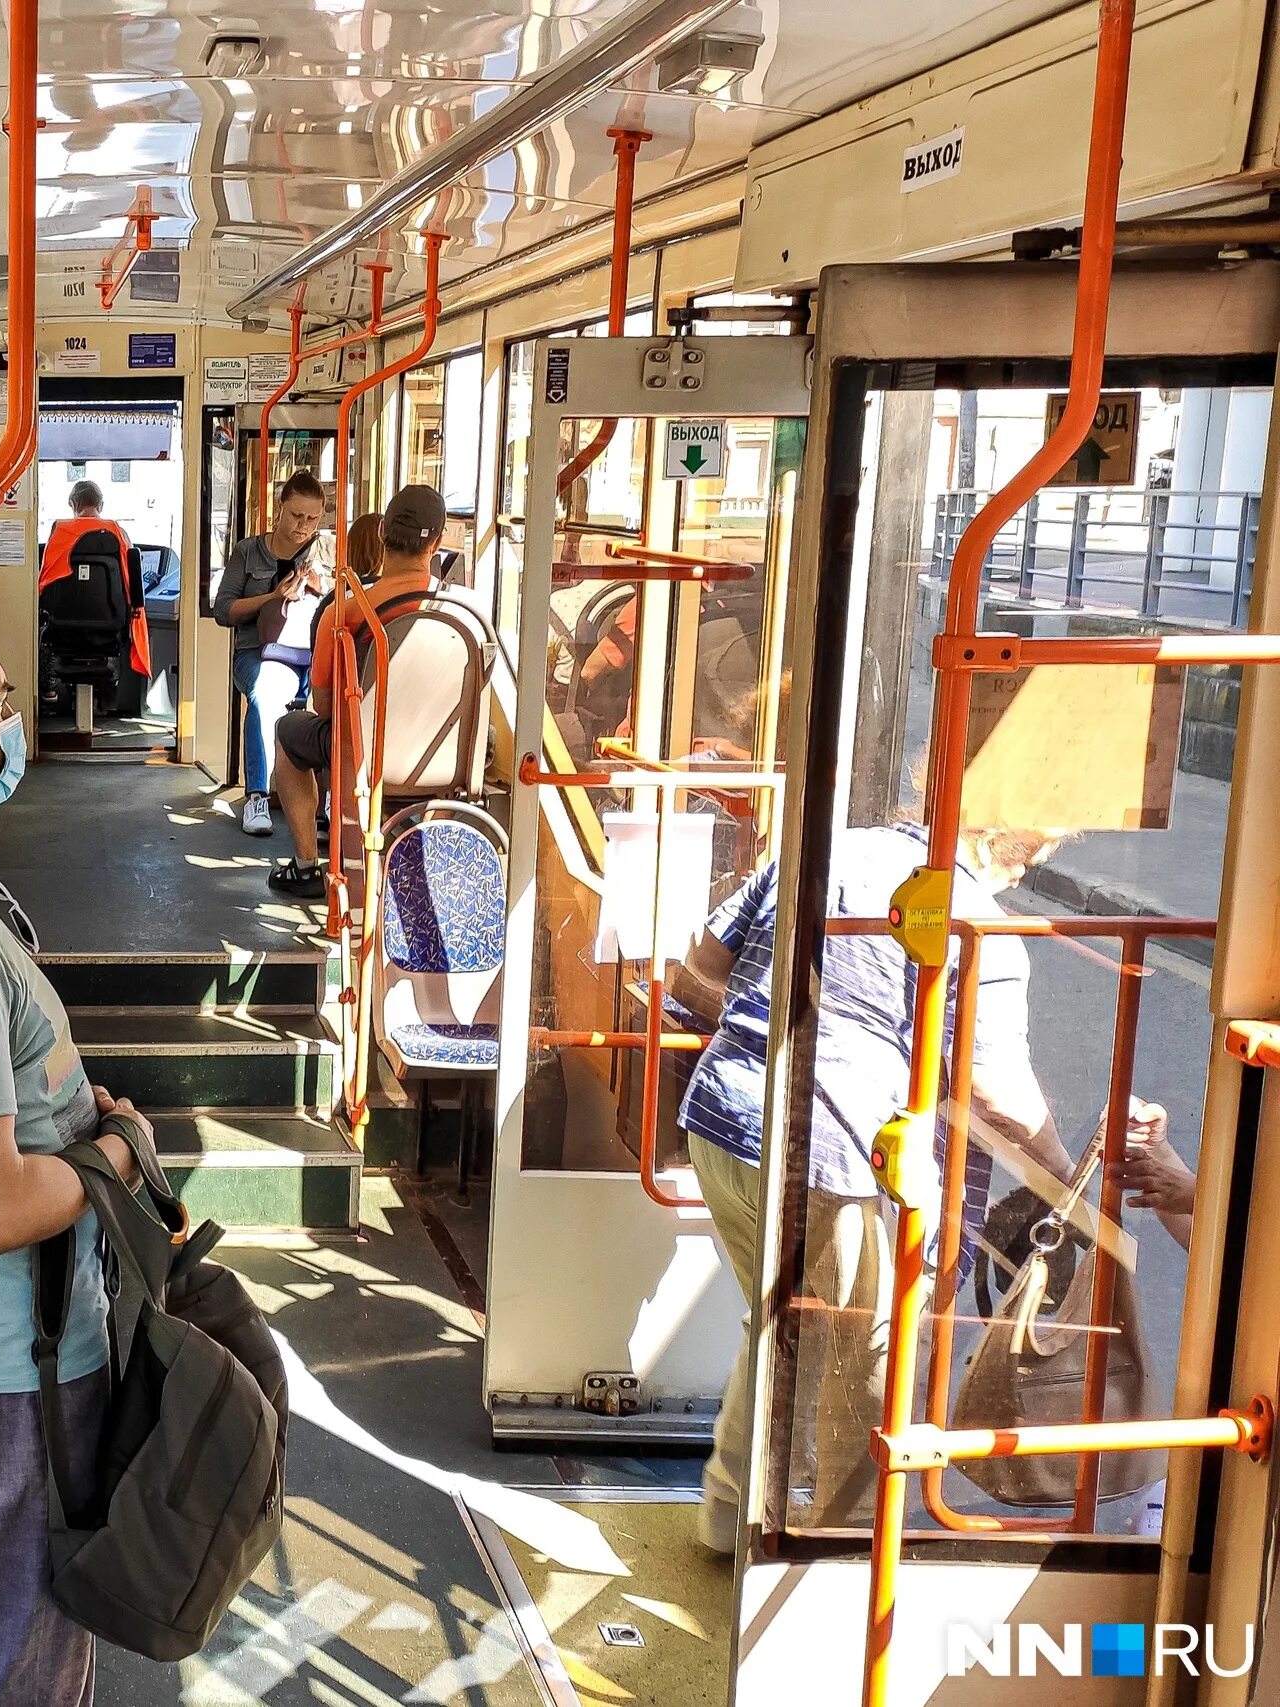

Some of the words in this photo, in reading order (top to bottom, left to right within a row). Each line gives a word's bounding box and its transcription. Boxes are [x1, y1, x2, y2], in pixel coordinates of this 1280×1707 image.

[903, 137, 963, 181] ВЫХОД
[64, 337, 87, 350] 1024
[211, 360, 242, 369] ВОДИТЕЛЬ
[209, 381, 243, 390] КОНДУКТОР
[670, 425, 720, 443] ВЫХОД
